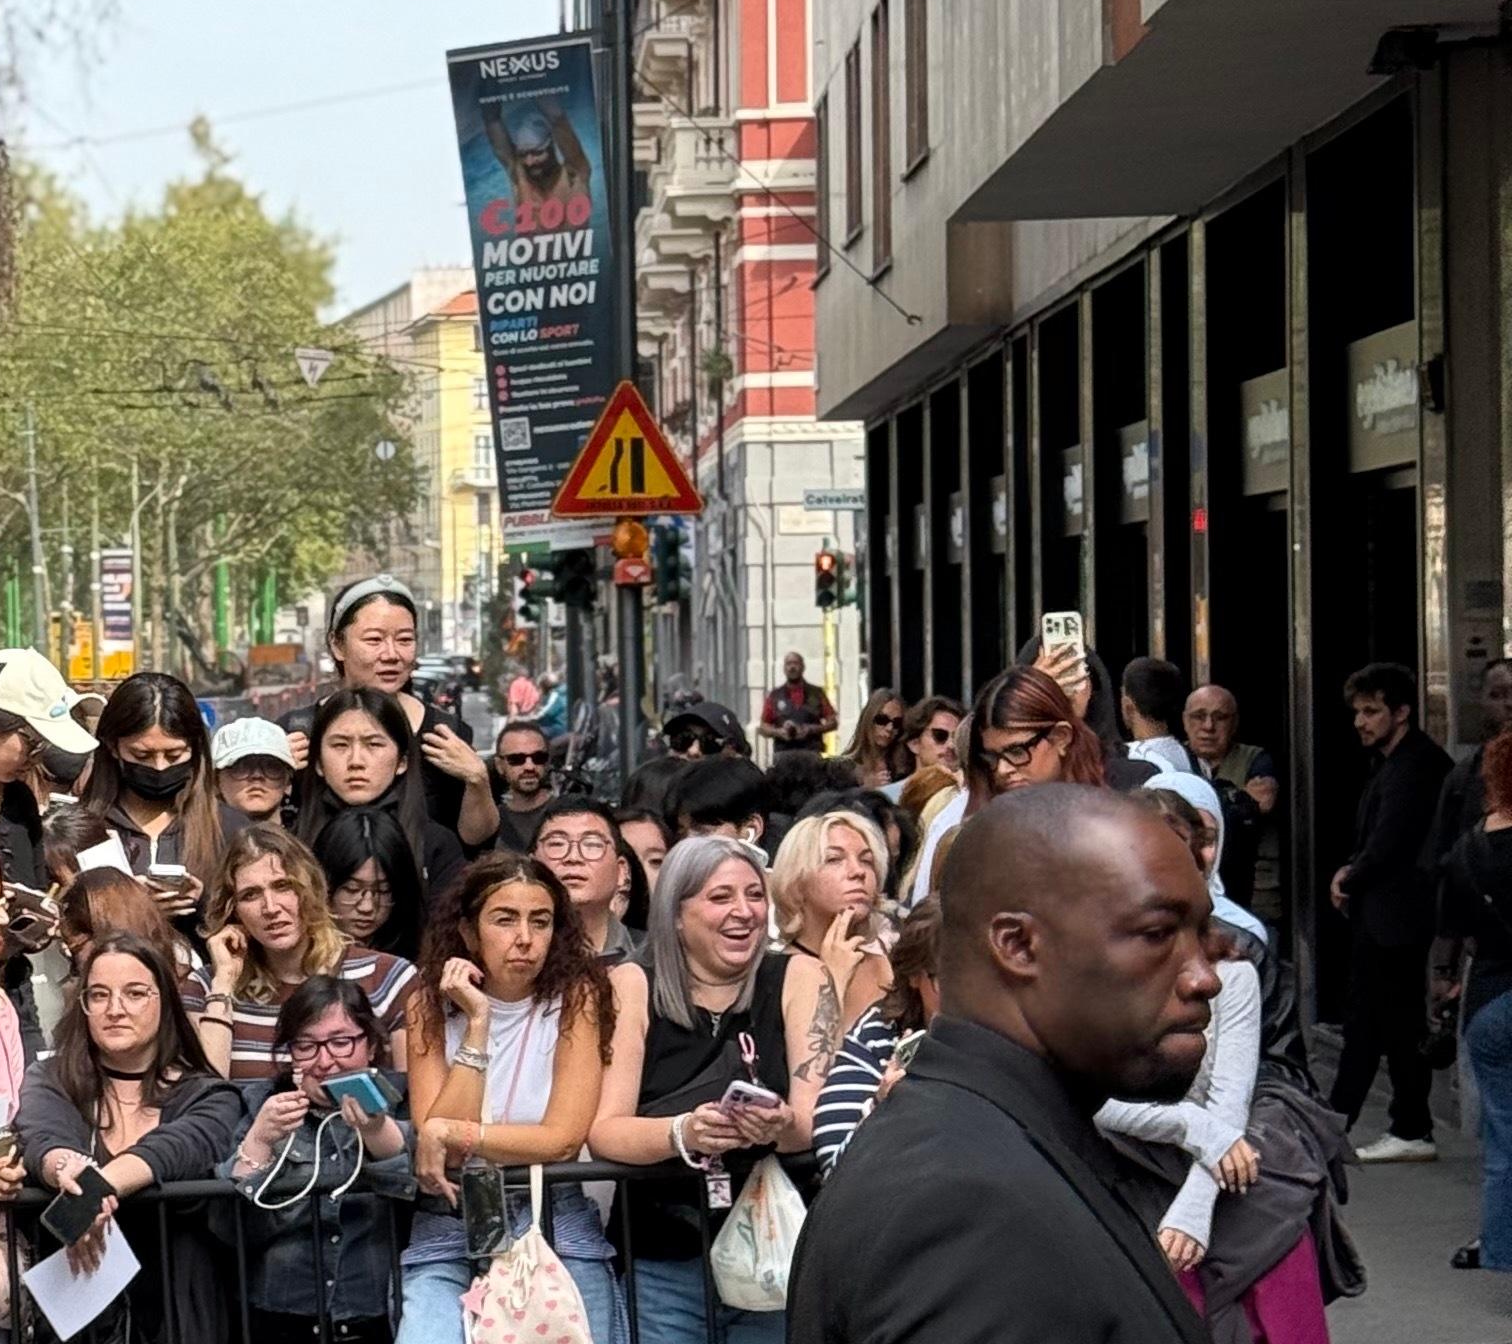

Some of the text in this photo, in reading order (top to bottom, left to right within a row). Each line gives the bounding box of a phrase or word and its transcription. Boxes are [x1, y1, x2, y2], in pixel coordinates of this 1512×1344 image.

[479, 51, 560, 79] NEXUS
[482, 228, 594, 269] MOTIVI
[484, 259, 600, 288] PER NUOTARE
[487, 280, 597, 315] CON NOI
[490, 323, 580, 345] CON LO SPORT
